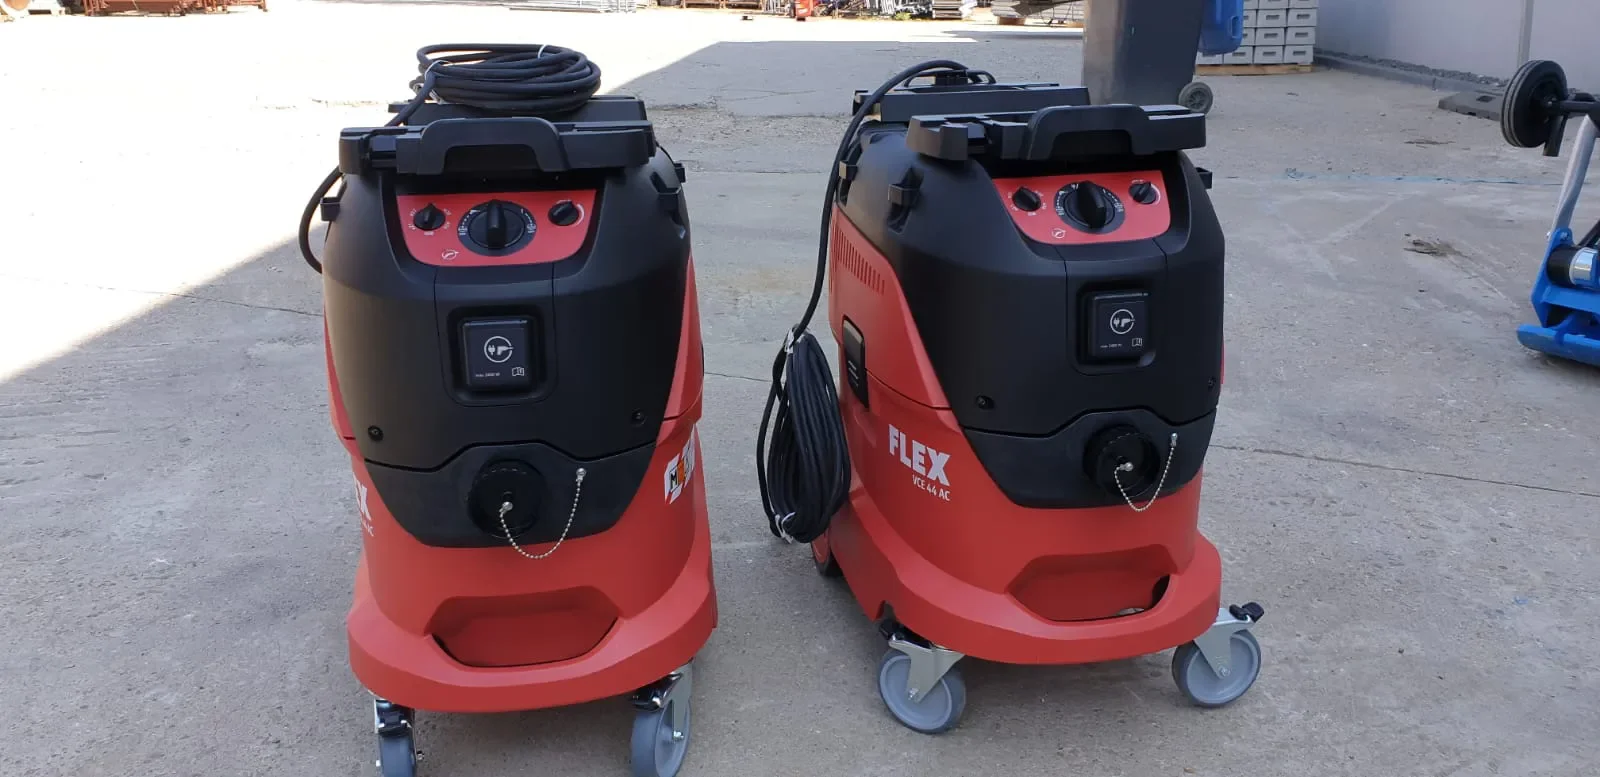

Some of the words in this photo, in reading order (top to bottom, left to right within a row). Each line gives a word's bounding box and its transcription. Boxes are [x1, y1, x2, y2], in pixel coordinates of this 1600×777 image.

[888, 423, 951, 487] FLEX
[912, 474, 926, 491] VCE
[926, 483, 937, 497] 44
[938, 488, 951, 502] AC
